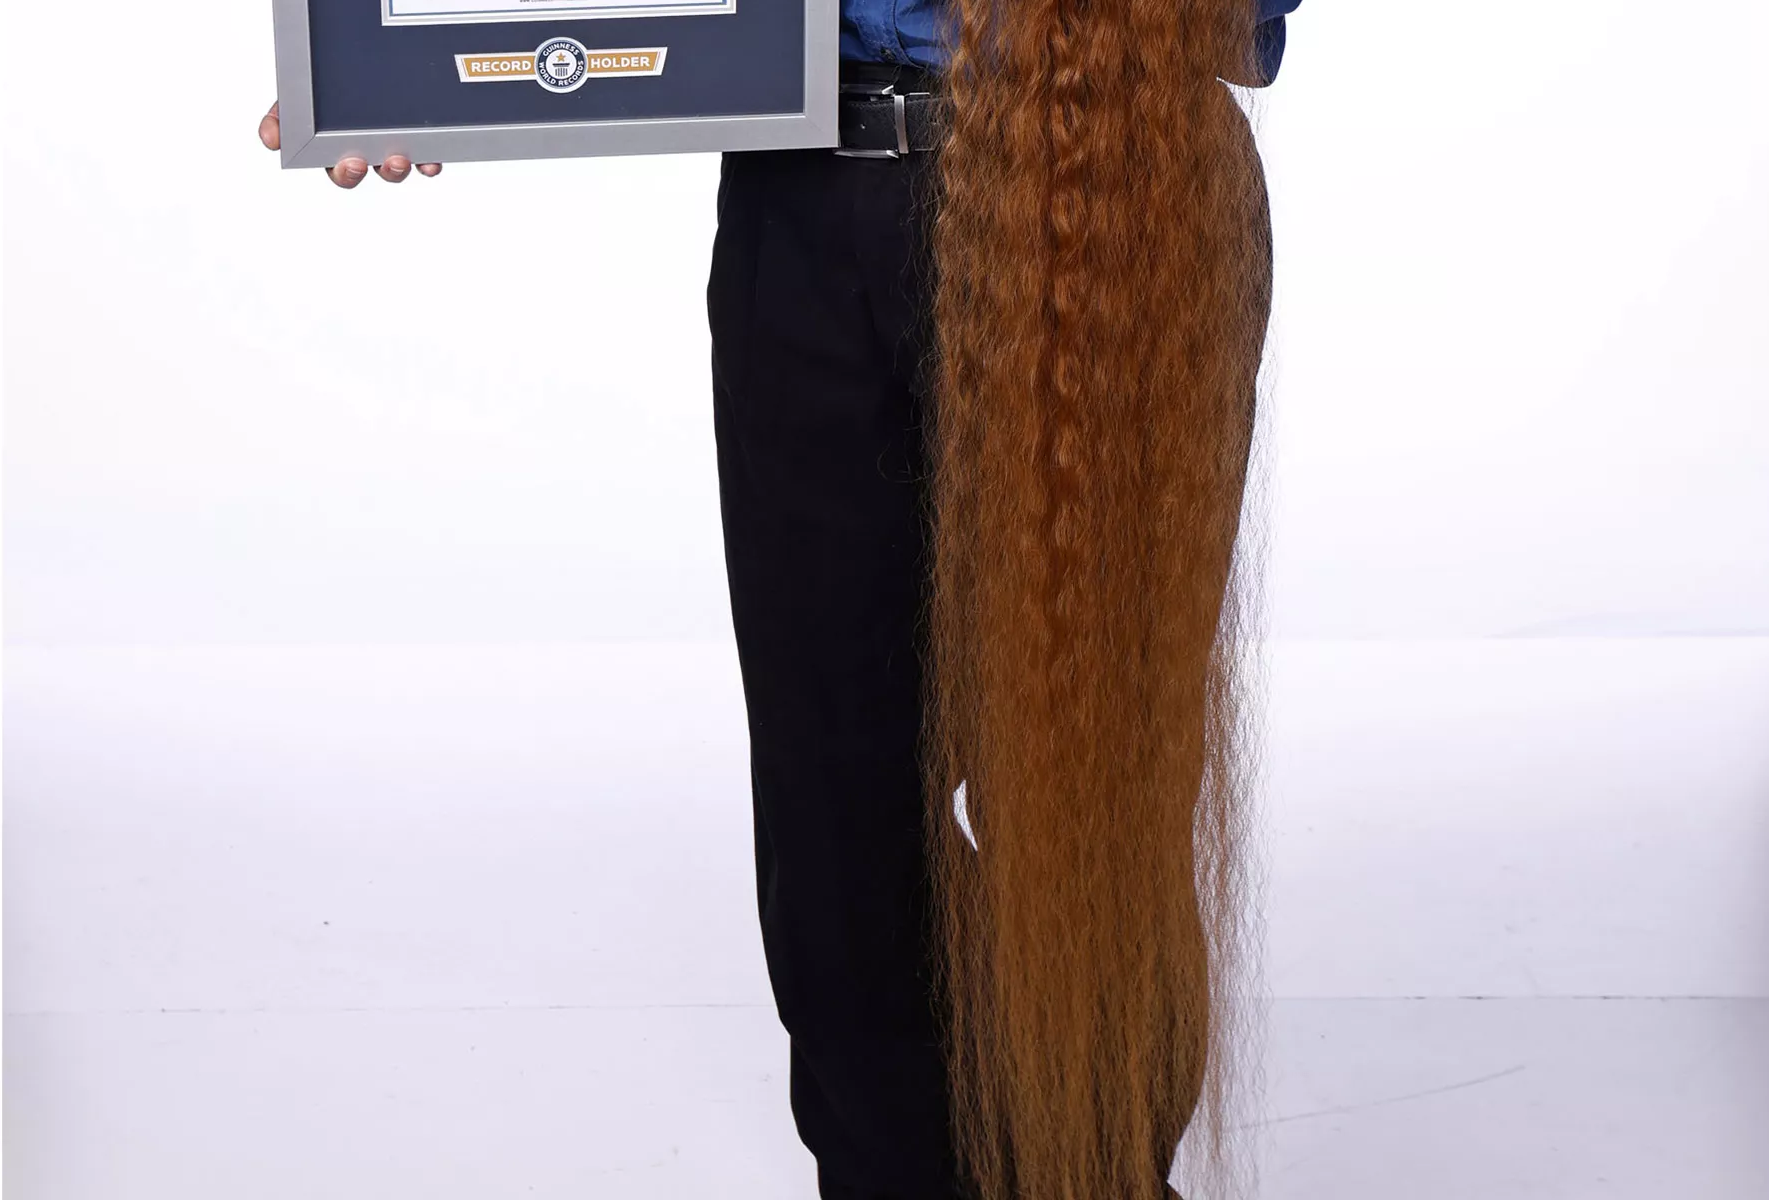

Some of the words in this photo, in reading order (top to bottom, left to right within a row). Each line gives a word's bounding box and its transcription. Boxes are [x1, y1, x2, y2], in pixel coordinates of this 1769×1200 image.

[543, 43, 580, 56] GUINNESS
[472, 60, 531, 72] RECORD
[591, 57, 650, 68] HOLDER
[539, 61, 556, 84] WORLD
[558, 61, 584, 86] RECORDS
